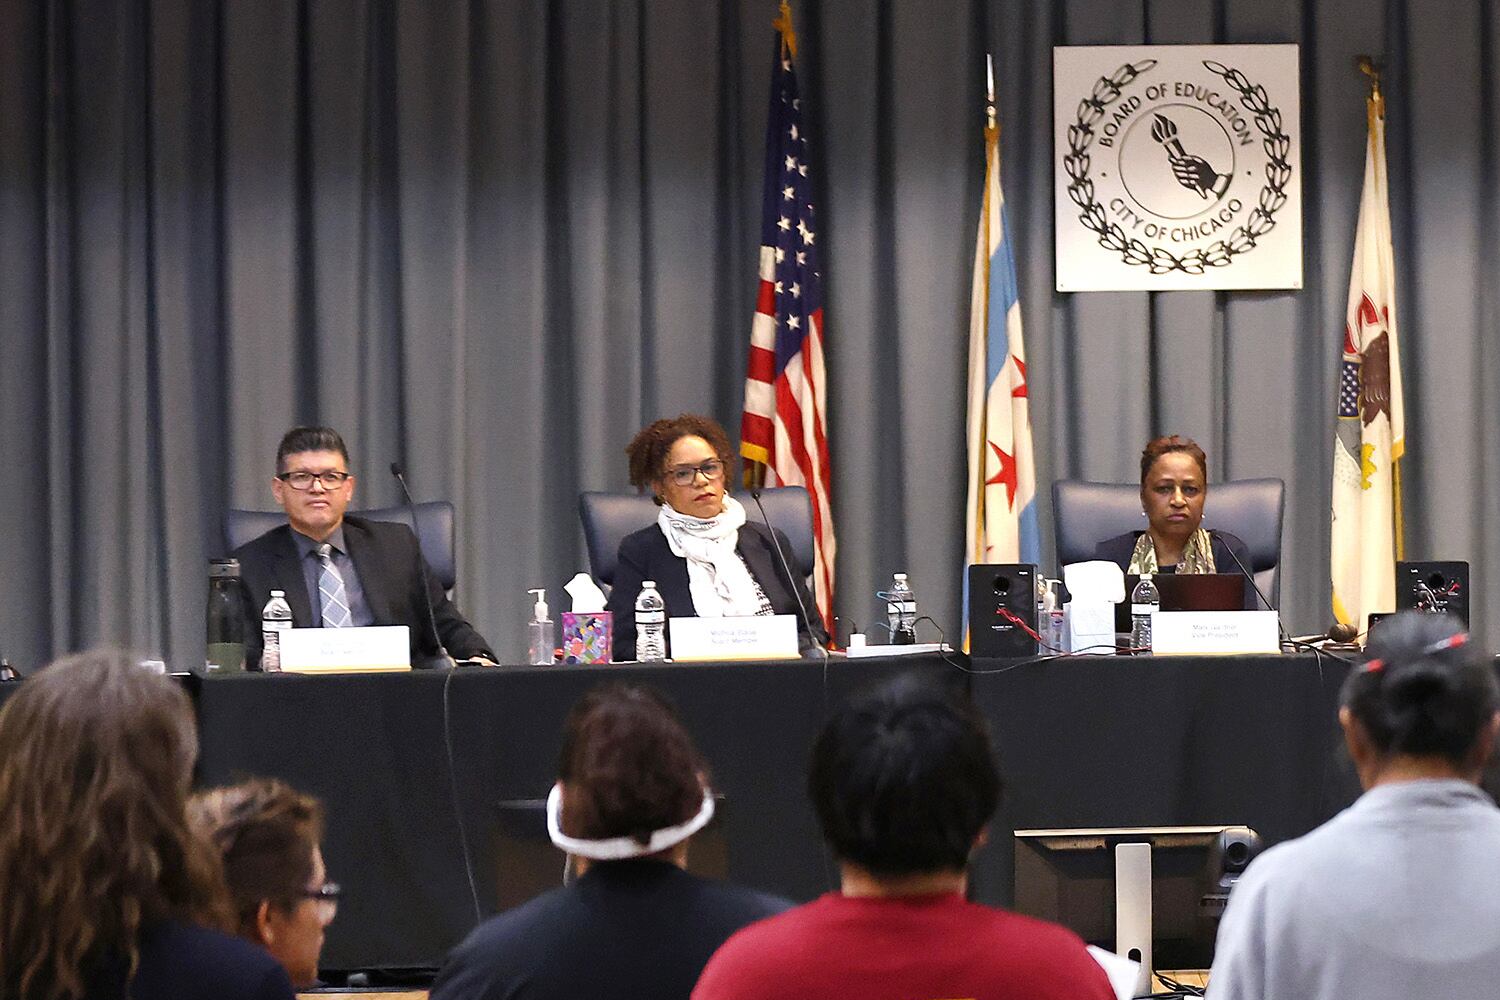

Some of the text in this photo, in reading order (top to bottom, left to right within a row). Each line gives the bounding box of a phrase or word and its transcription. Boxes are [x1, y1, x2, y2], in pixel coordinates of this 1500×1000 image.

[1099, 82, 1254, 148] BOARD OF EDUCATION
[1110, 198, 1243, 243] CITY OF CHICAGO
